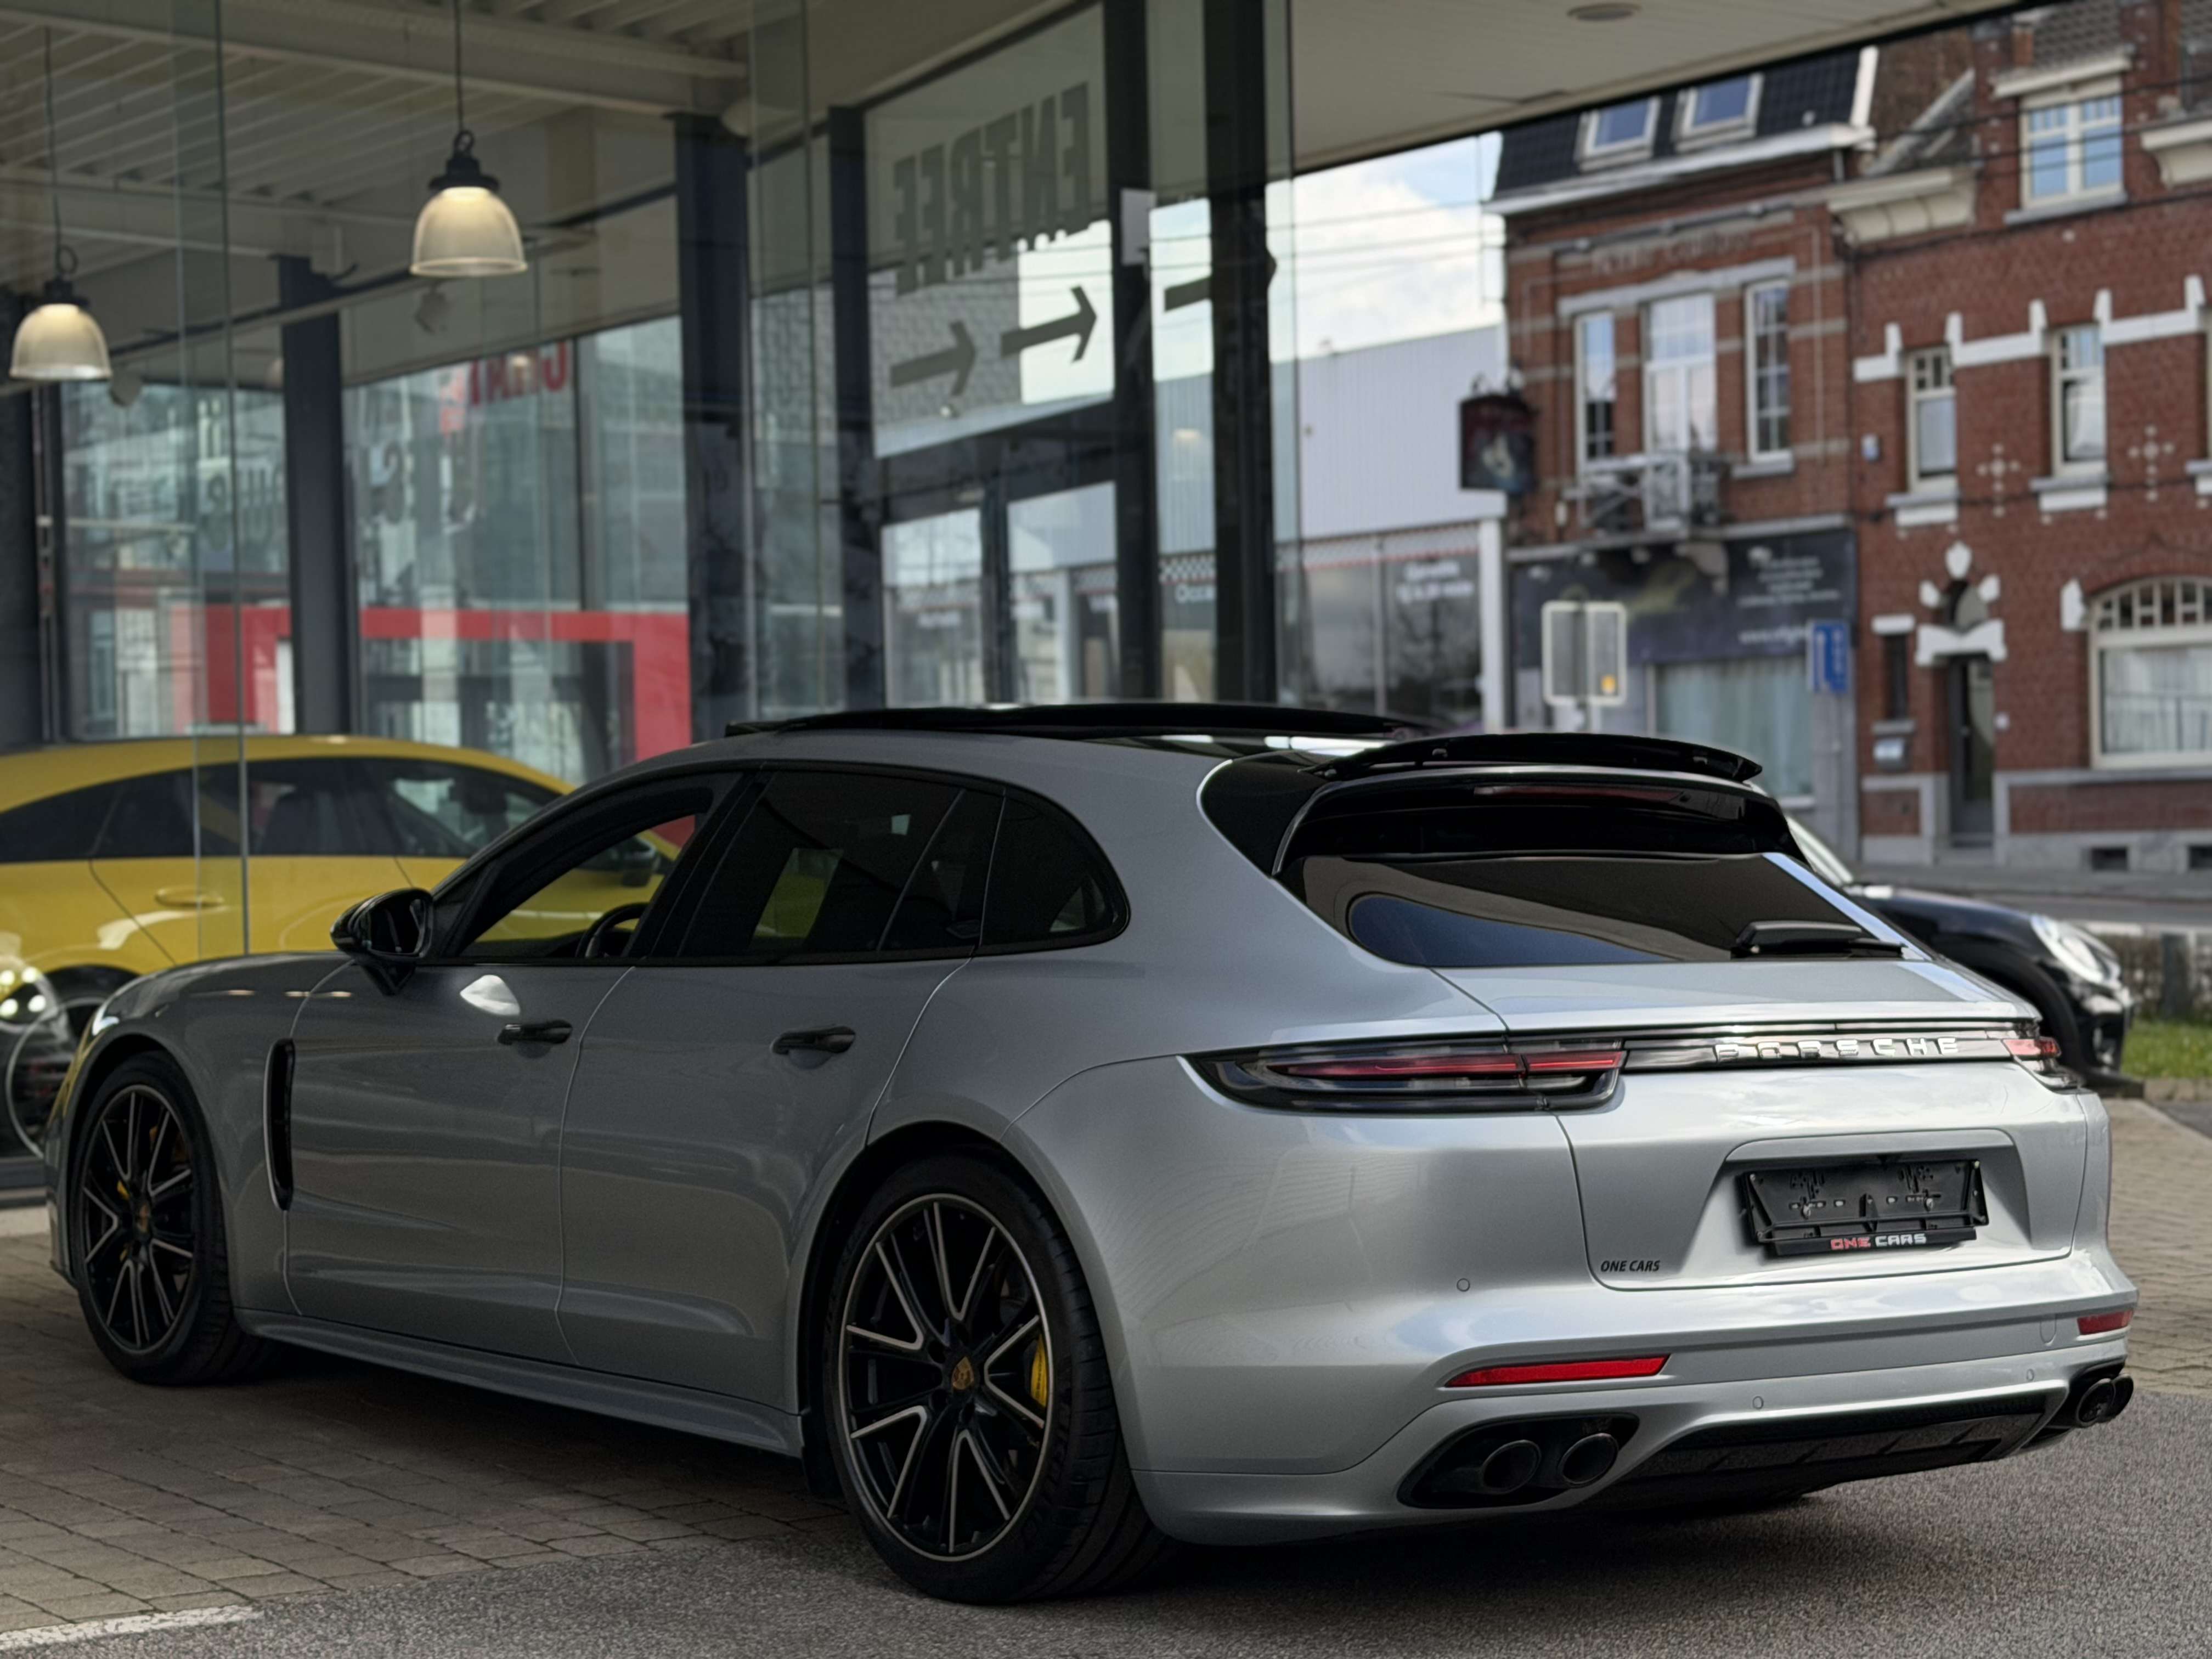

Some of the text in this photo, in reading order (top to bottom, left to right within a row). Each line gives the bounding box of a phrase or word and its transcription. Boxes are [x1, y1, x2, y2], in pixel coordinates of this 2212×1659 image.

[1714, 1037, 1959, 1062] PORSCHE
[1830, 1233, 1927, 1251] ONE CARS
[1600, 1260, 1661, 1272] ONE CARS
